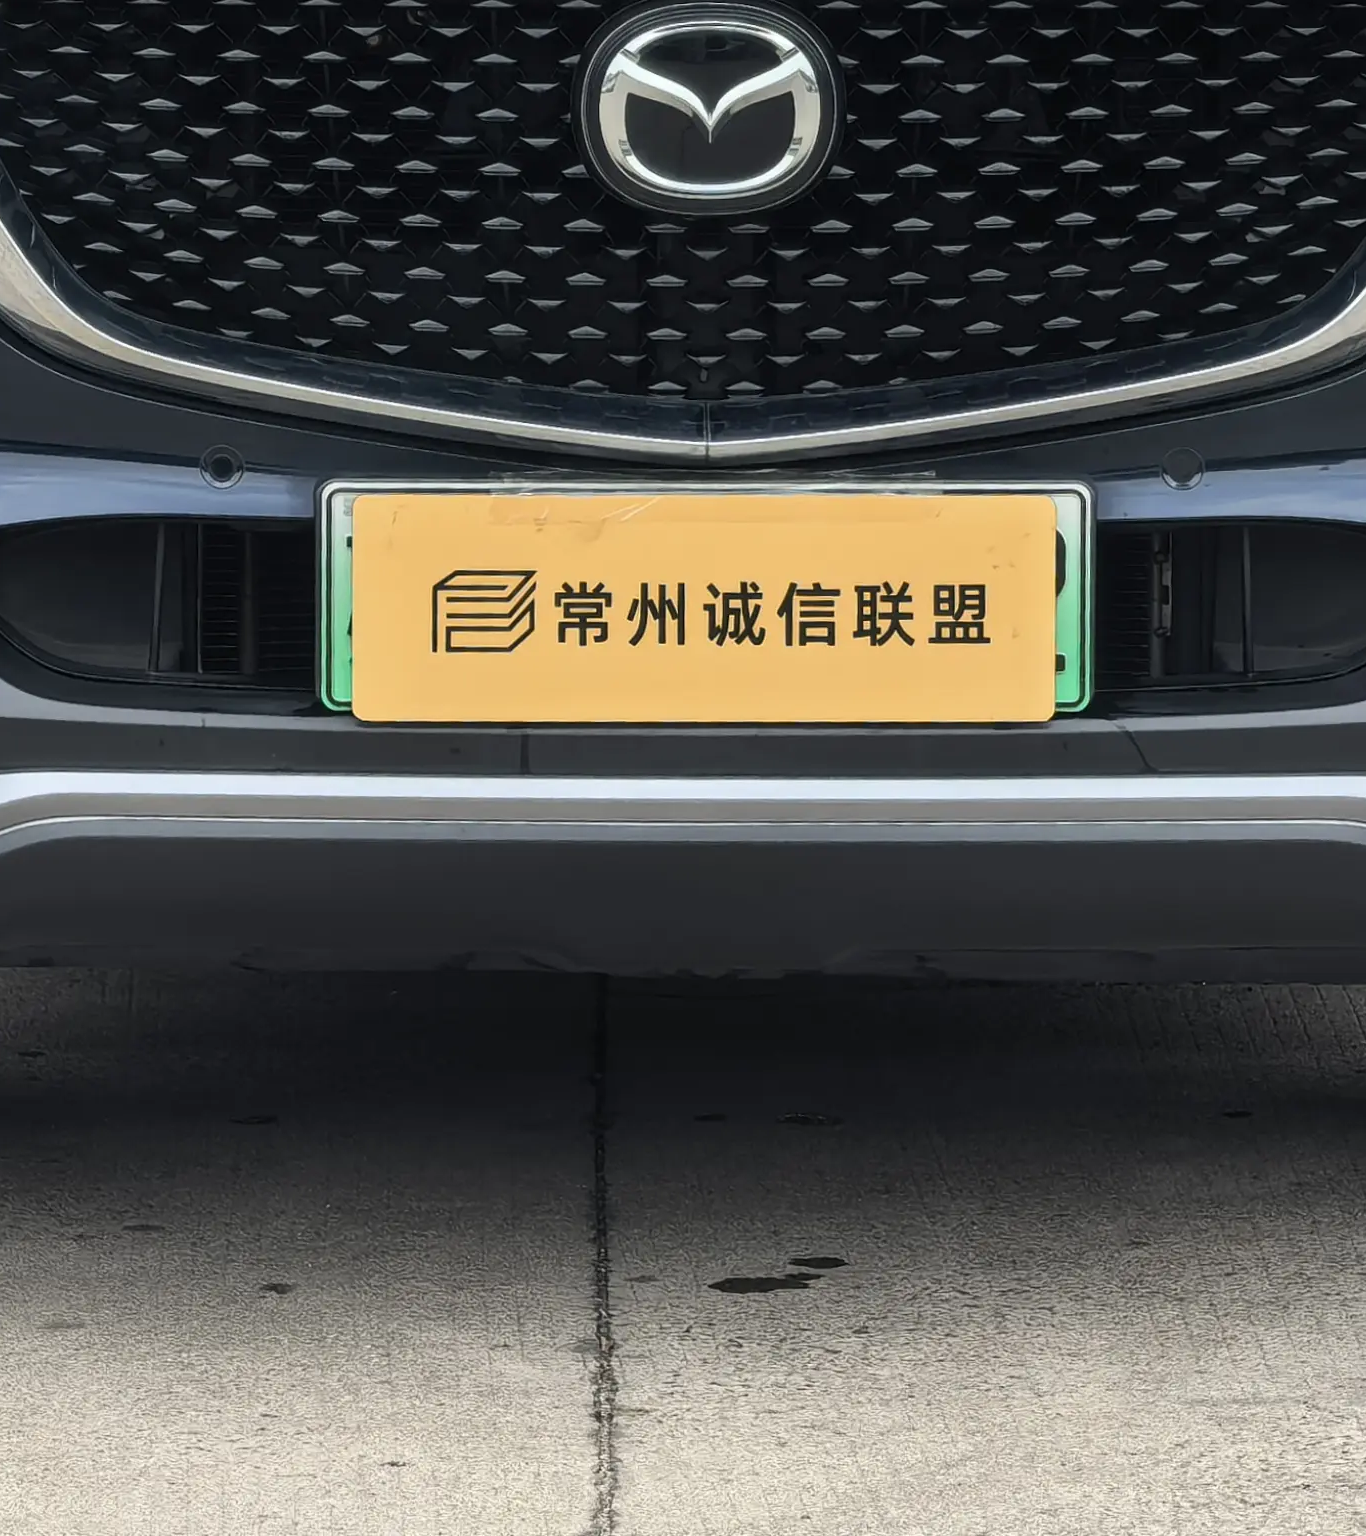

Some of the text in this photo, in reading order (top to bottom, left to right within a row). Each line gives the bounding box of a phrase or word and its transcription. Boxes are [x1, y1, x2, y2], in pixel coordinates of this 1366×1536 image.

[553, 580, 992, 647] 常州诚信联盟
